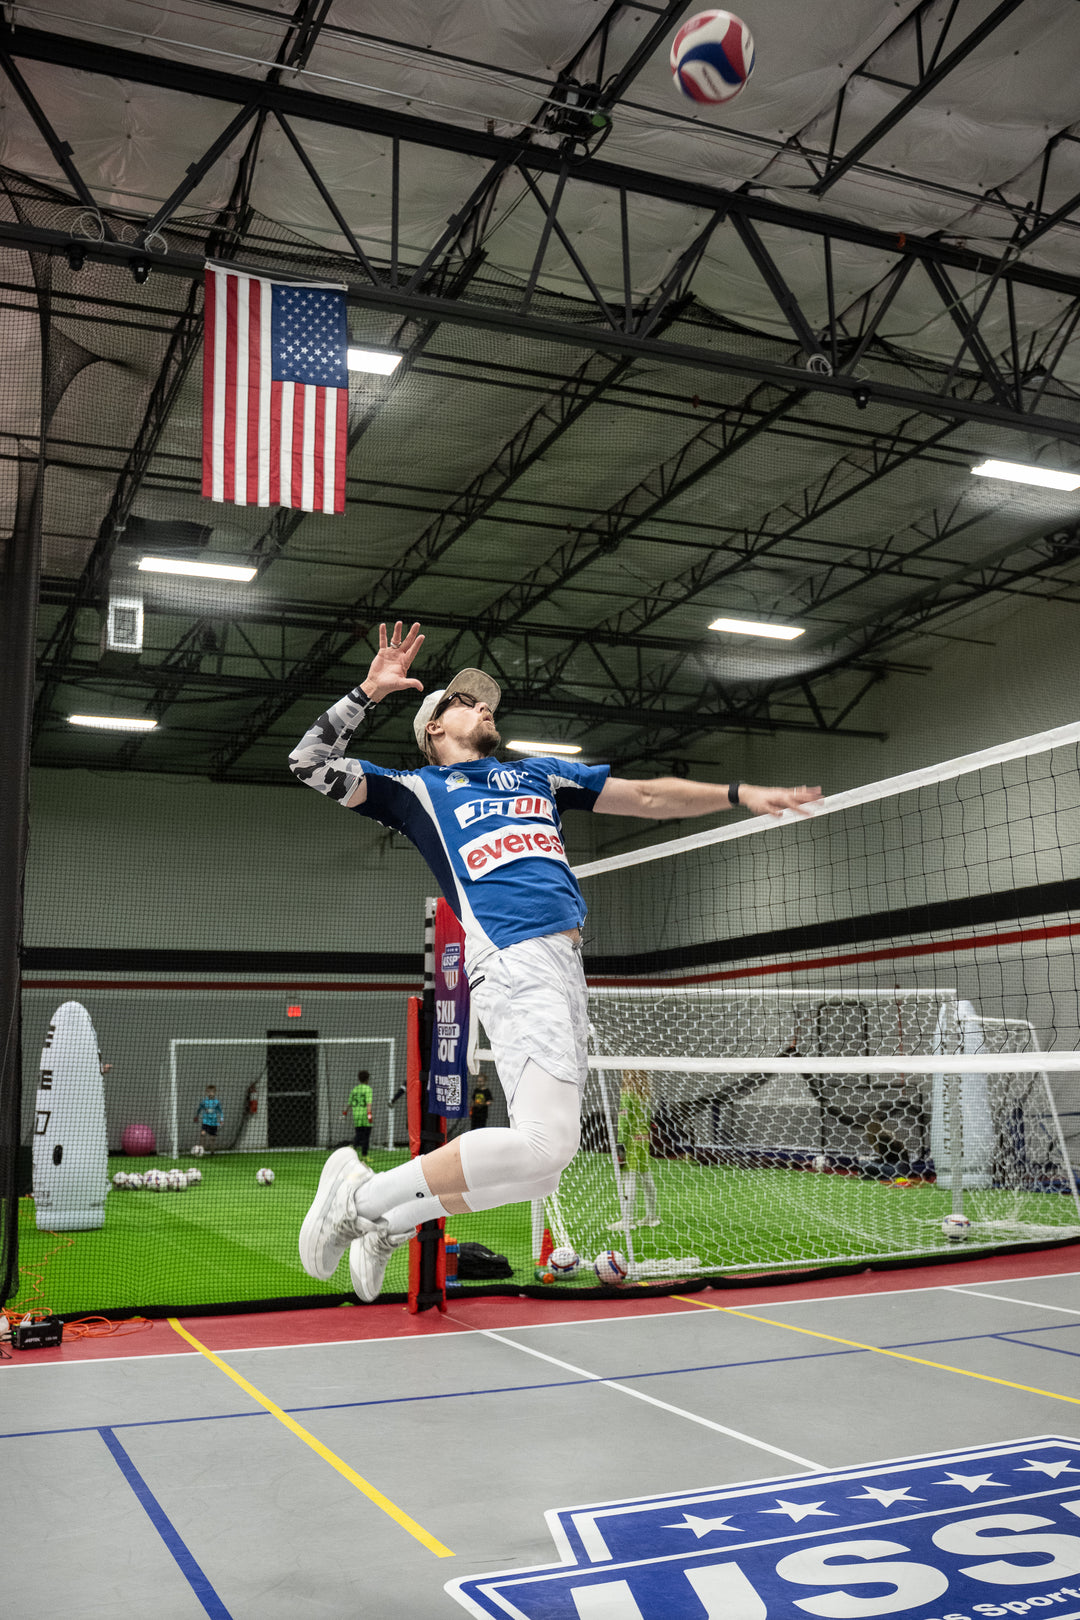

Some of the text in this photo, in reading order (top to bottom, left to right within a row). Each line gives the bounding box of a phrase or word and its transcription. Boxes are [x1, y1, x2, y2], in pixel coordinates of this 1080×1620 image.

[465, 797, 553, 826] JETOIL
[466, 831, 566, 872] everes
[569, 1500, 1080, 1620] USS
[972, 1586, 1080, 1617] Sport
